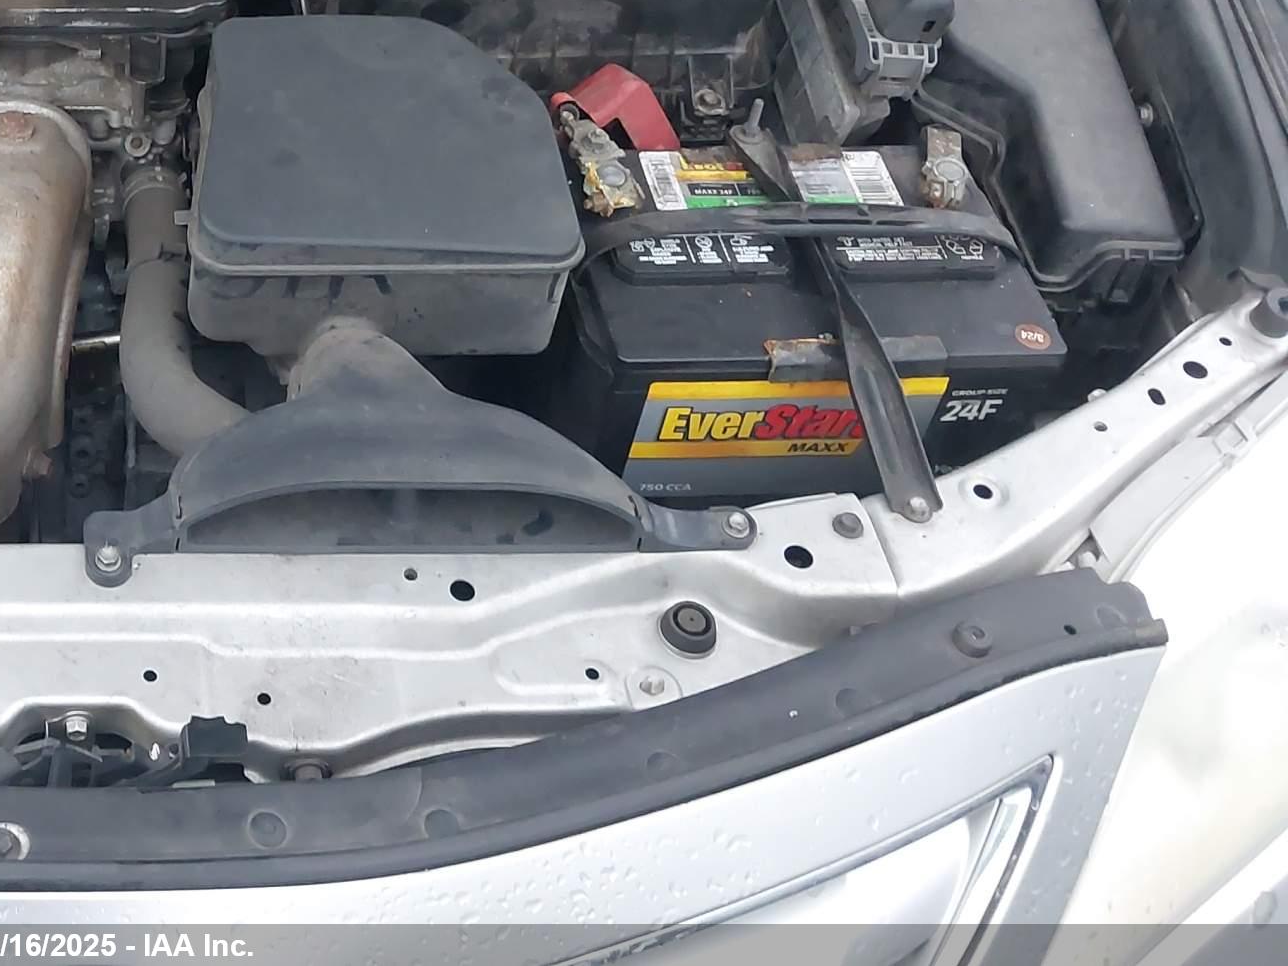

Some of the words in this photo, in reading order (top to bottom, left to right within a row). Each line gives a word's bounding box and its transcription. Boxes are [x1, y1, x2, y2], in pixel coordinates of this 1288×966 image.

[939, 399, 1004, 422] 24F
[786, 441, 850, 453] MAXX
[640, 482, 664, 491] 750
[665, 482, 692, 491] CCA
